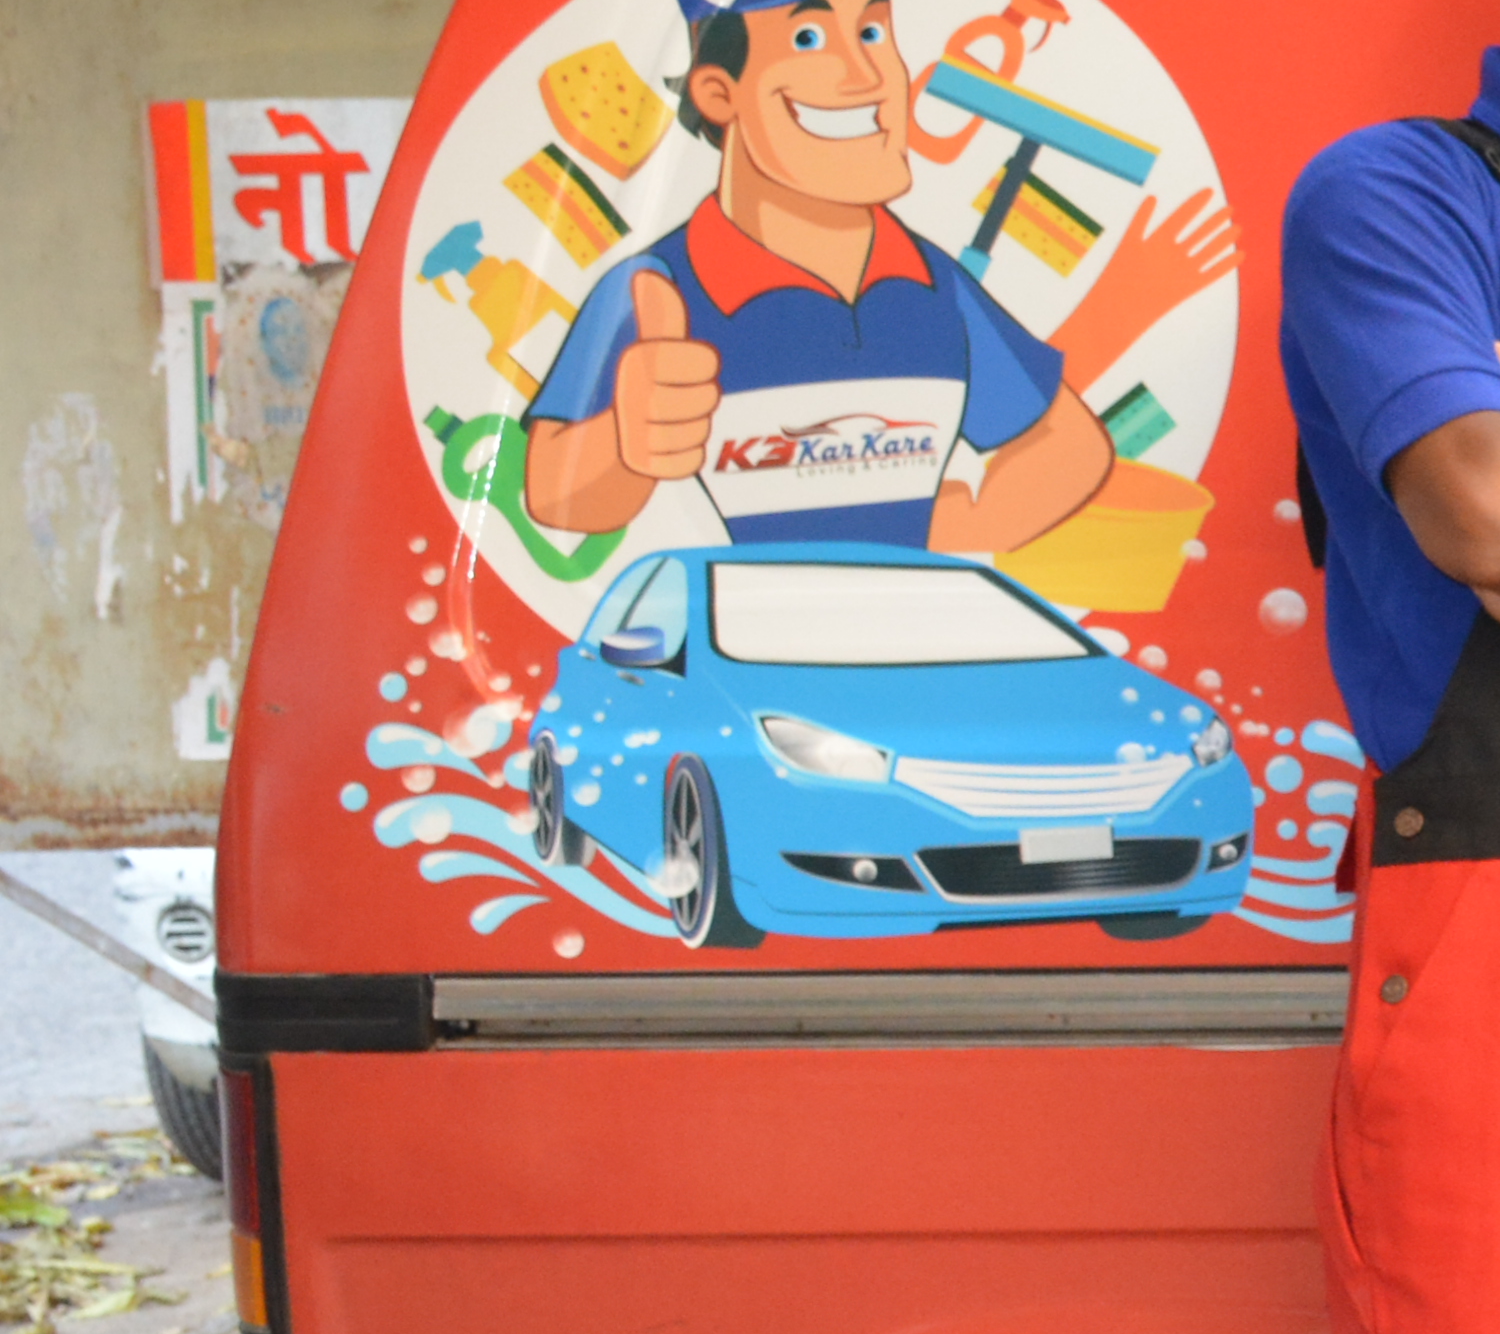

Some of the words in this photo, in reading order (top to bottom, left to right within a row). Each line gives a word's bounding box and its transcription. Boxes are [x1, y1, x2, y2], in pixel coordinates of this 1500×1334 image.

[714, 435, 798, 473] K3
[798, 438, 856, 466] Kar
[861, 431, 934, 463] Kare
